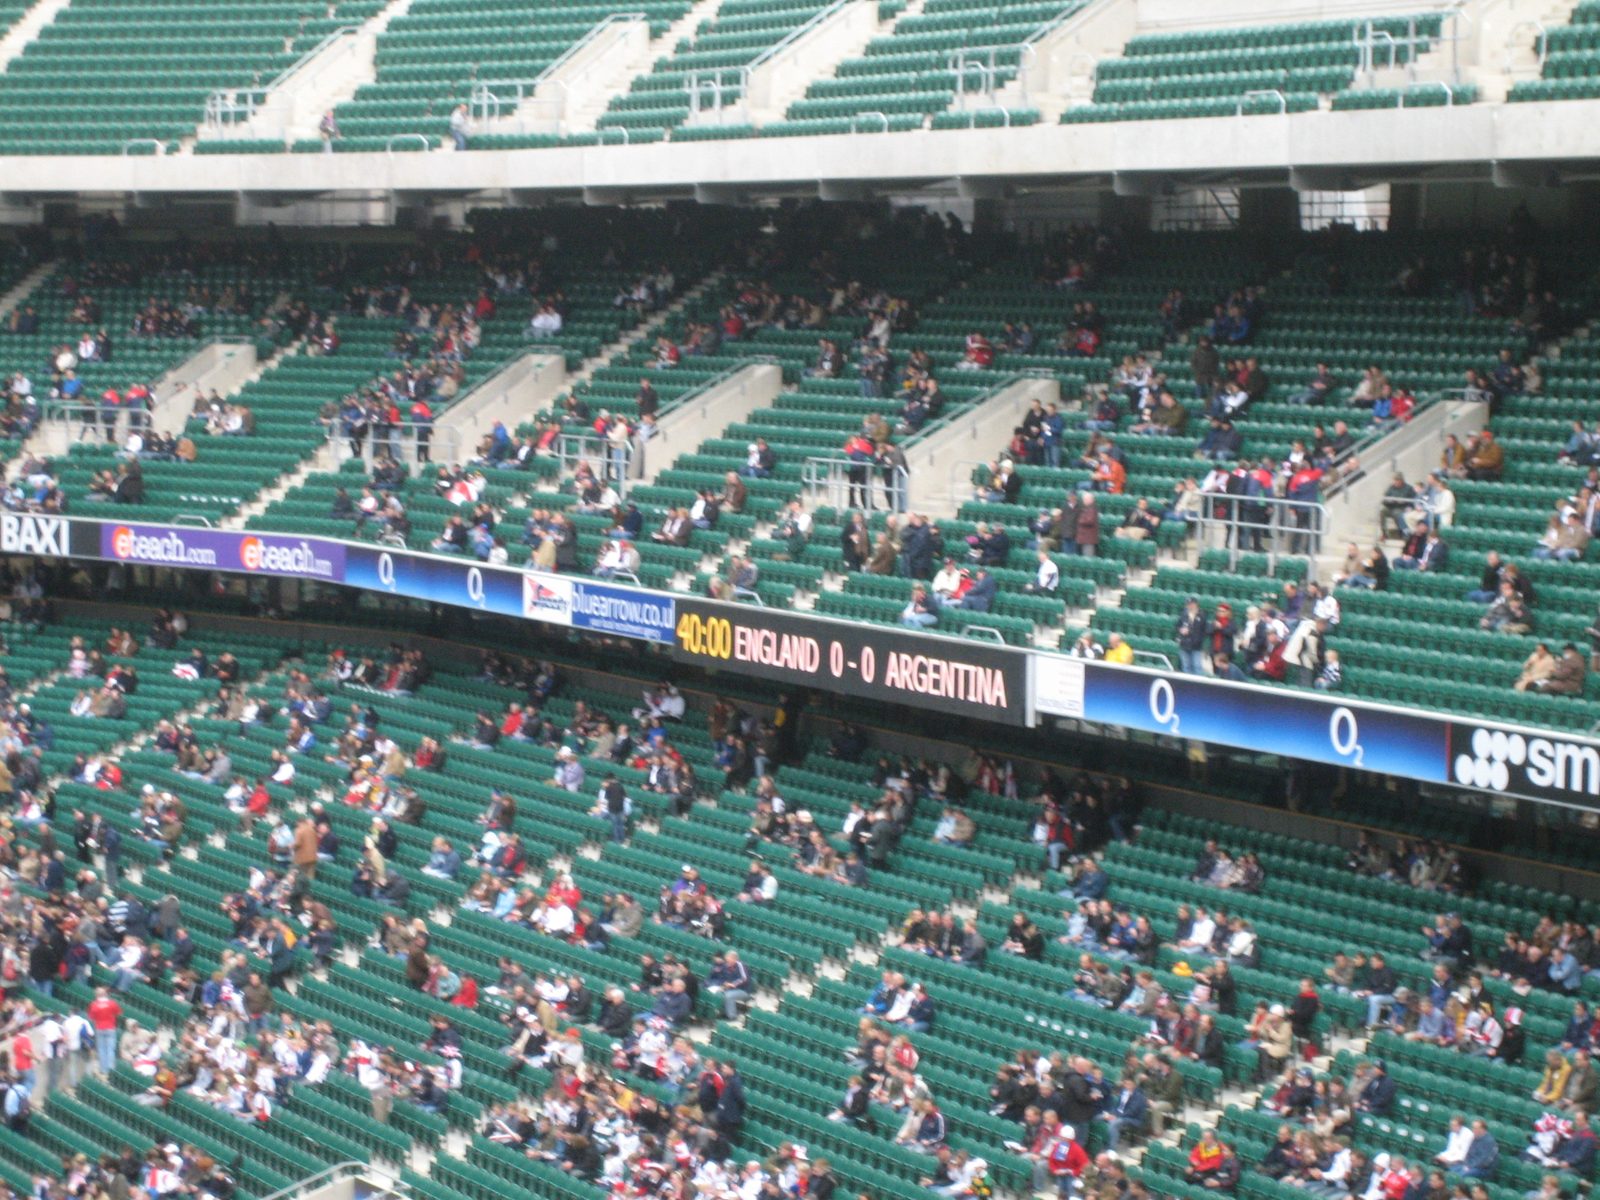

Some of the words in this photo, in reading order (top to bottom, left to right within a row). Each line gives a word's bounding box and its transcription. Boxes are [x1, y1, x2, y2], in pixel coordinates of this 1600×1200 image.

[0, 514, 70, 556] BAXI
[114, 529, 217, 565] eteach.com
[676, 613, 732, 660] 40:00
[734, 625, 820, 673] ENGLAND
[884, 651, 1007, 708] ARGENTINA
